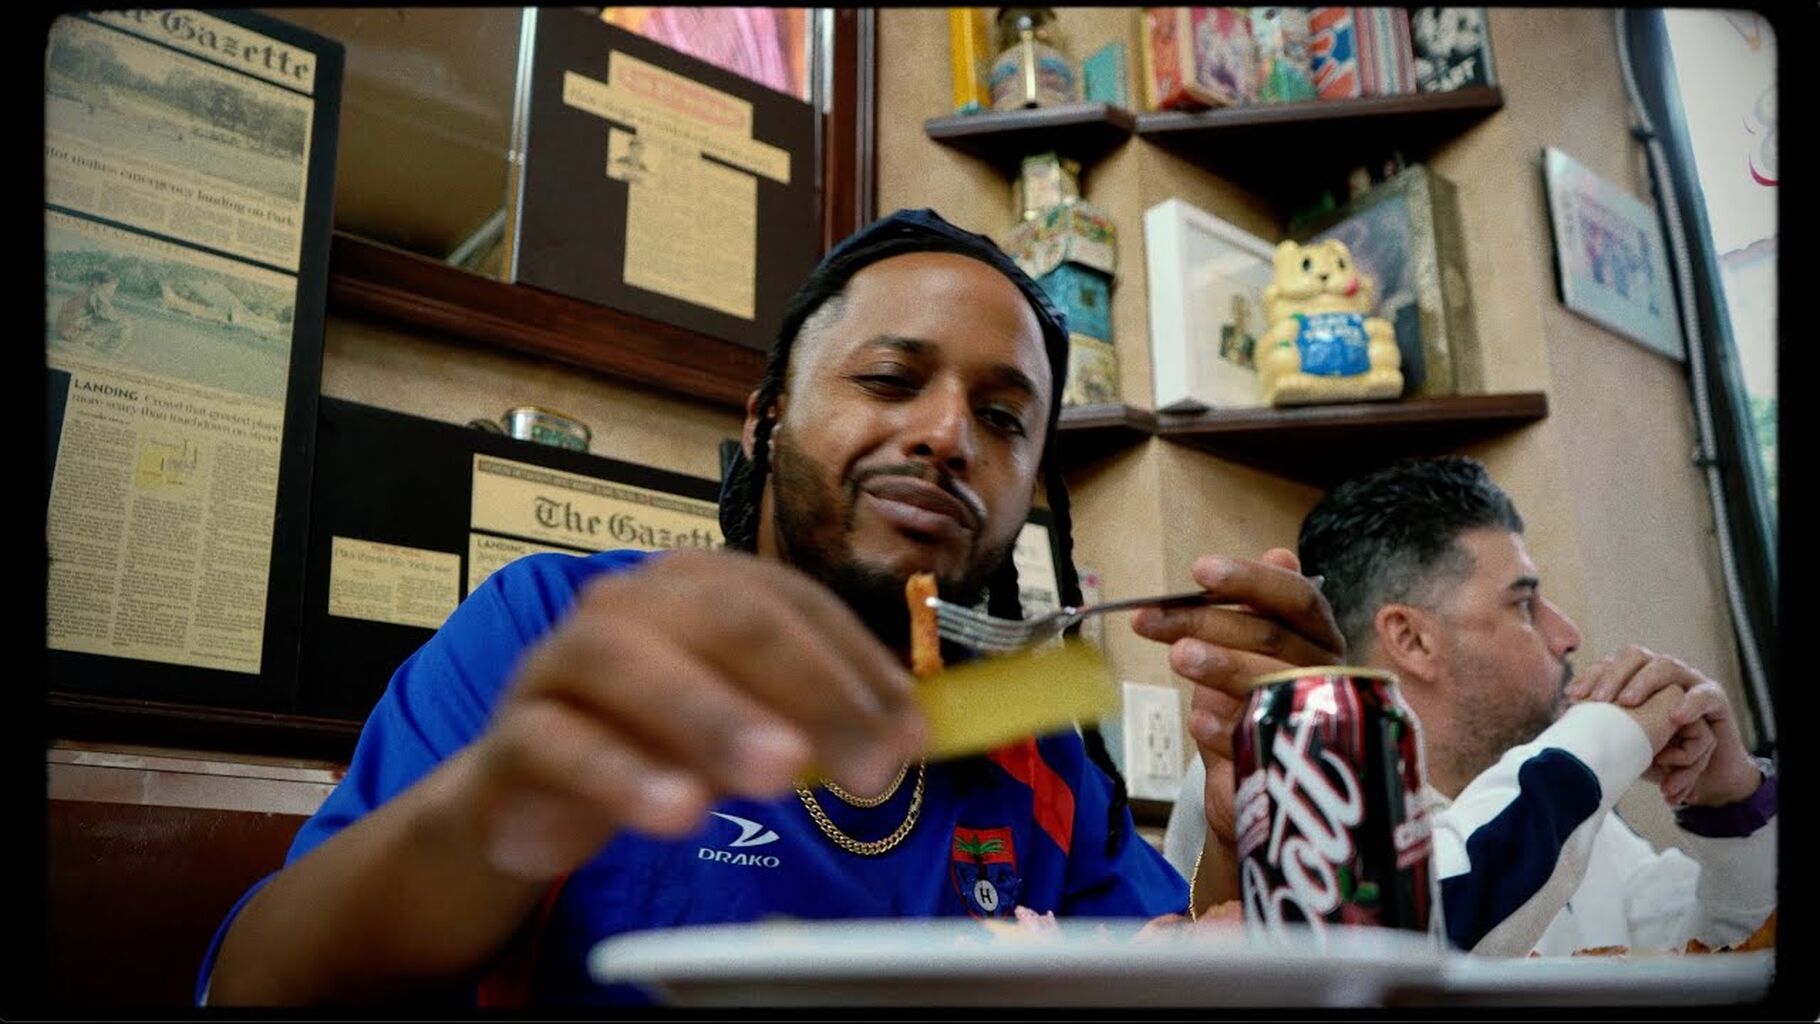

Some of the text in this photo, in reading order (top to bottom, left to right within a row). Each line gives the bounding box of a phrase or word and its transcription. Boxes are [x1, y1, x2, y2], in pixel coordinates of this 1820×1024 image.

[161, 10, 309, 80] Gazette
[198, 190, 246, 214] landing
[247, 207, 264, 217] on
[72, 394, 100, 405] more
[105, 401, 136, 416] scary
[141, 407, 167, 421] than
[169, 414, 230, 433] touchdown
[74, 379, 138, 401] LANDING
[144, 395, 184, 409] Crowd
[185, 402, 206, 416] that
[209, 410, 250, 426] greeted
[535, 495, 601, 535] The
[697, 847, 780, 868] DRAKO
[980, 887, 993, 904] H
